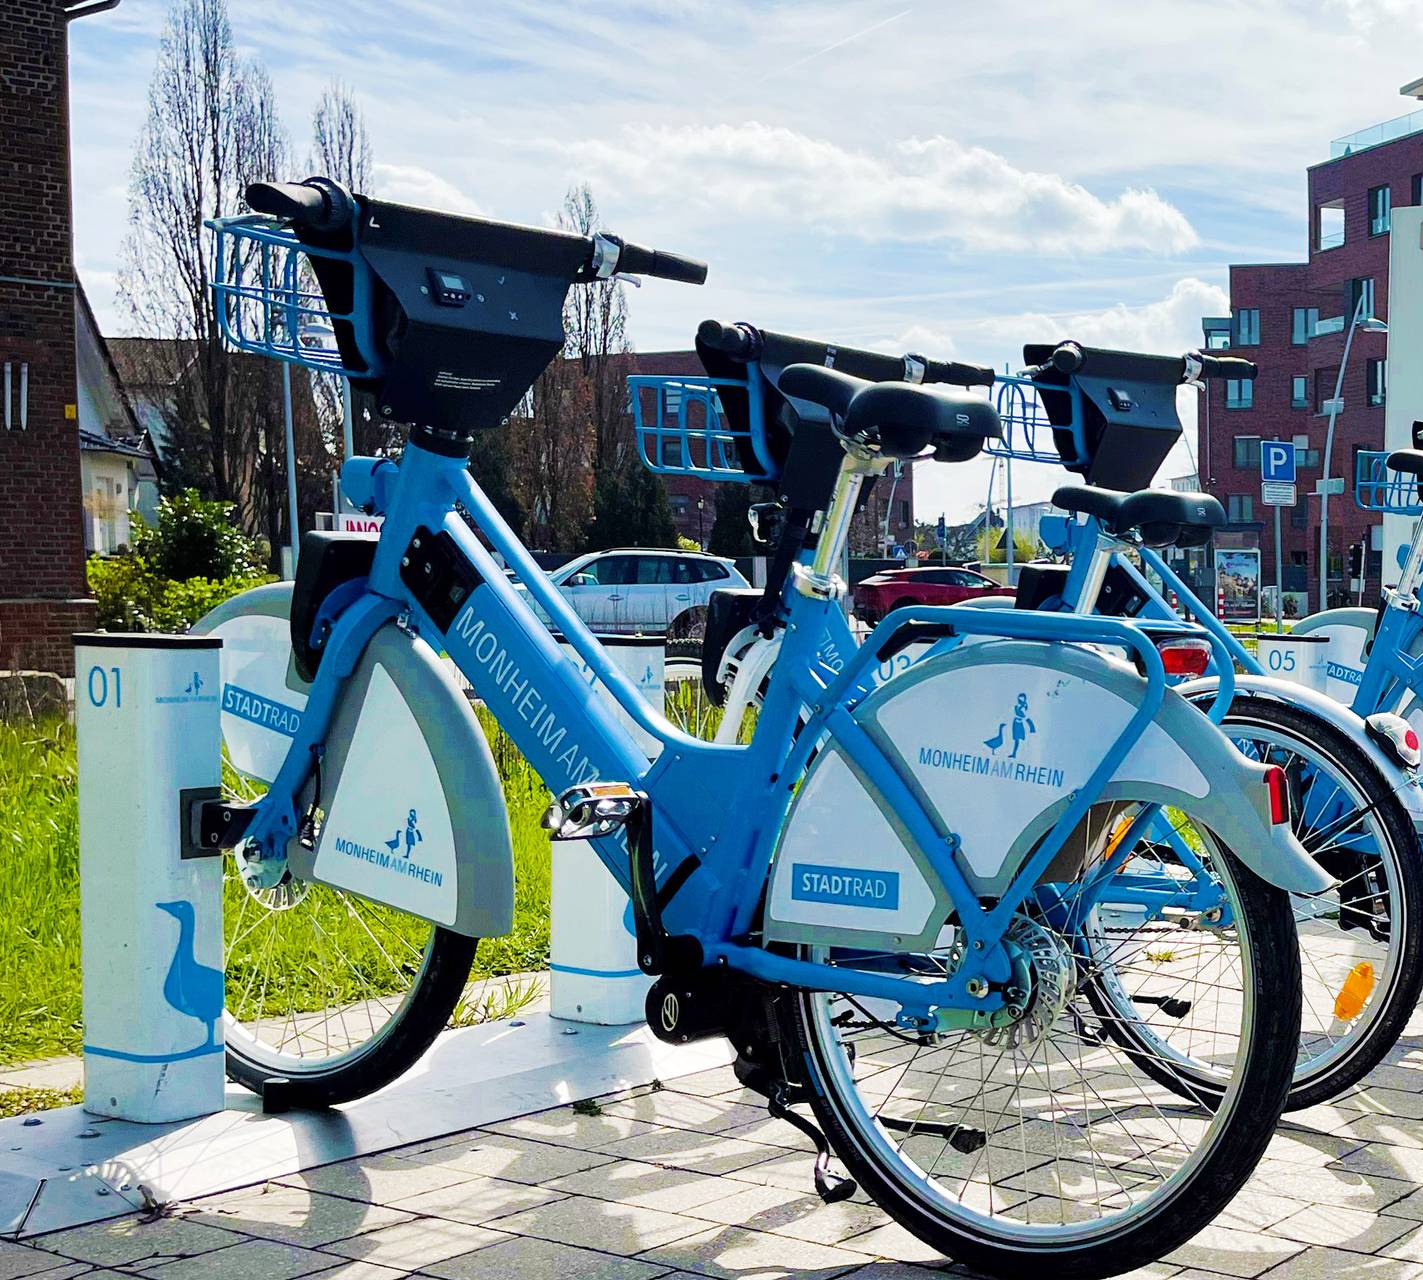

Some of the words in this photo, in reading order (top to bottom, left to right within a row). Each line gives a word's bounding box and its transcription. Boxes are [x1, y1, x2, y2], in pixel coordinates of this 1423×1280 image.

[1270, 447, 1288, 476] P
[456, 606, 568, 755] MONHEIM
[1269, 650, 1296, 671] 05
[88, 666, 121, 708] 01
[225, 689, 300, 734] STADTRAD
[919, 747, 991, 775] MONHEIM
[991, 759, 1013, 779] AM
[1015, 763, 1064, 788] RHEIN
[335, 837, 390, 868] MONHEIM
[408, 864, 442, 887] RHEIN
[802, 872, 887, 899] STADTRAD
